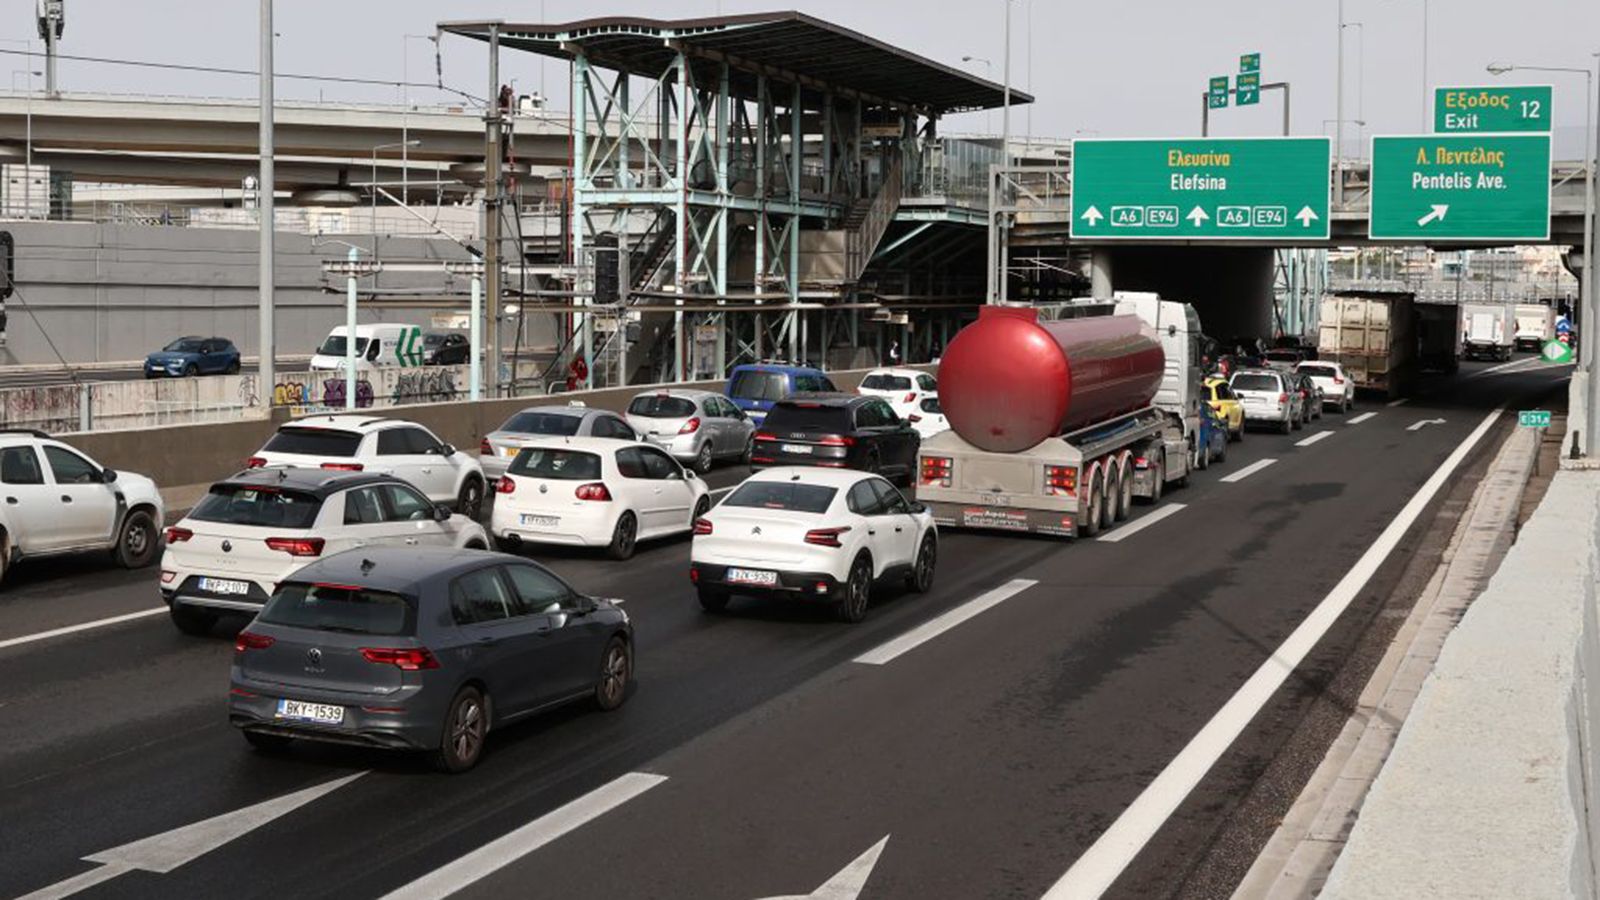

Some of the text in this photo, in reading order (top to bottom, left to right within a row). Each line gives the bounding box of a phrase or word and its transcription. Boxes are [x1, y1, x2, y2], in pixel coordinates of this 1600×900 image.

[1520, 101, 1540, 118] 12
[1445, 114, 1478, 128] Exit
[1168, 149, 1230, 167] Ελευσίνα
[1416, 147, 1505, 167] Λ. Πεντέλης
[1171, 173, 1226, 190] Elefsina
[1412, 172, 1507, 189] Pentelis Ave.
[1119, 210, 1282, 222] A6 E94 A6 E94
[286, 702, 343, 720] BKY-1539
